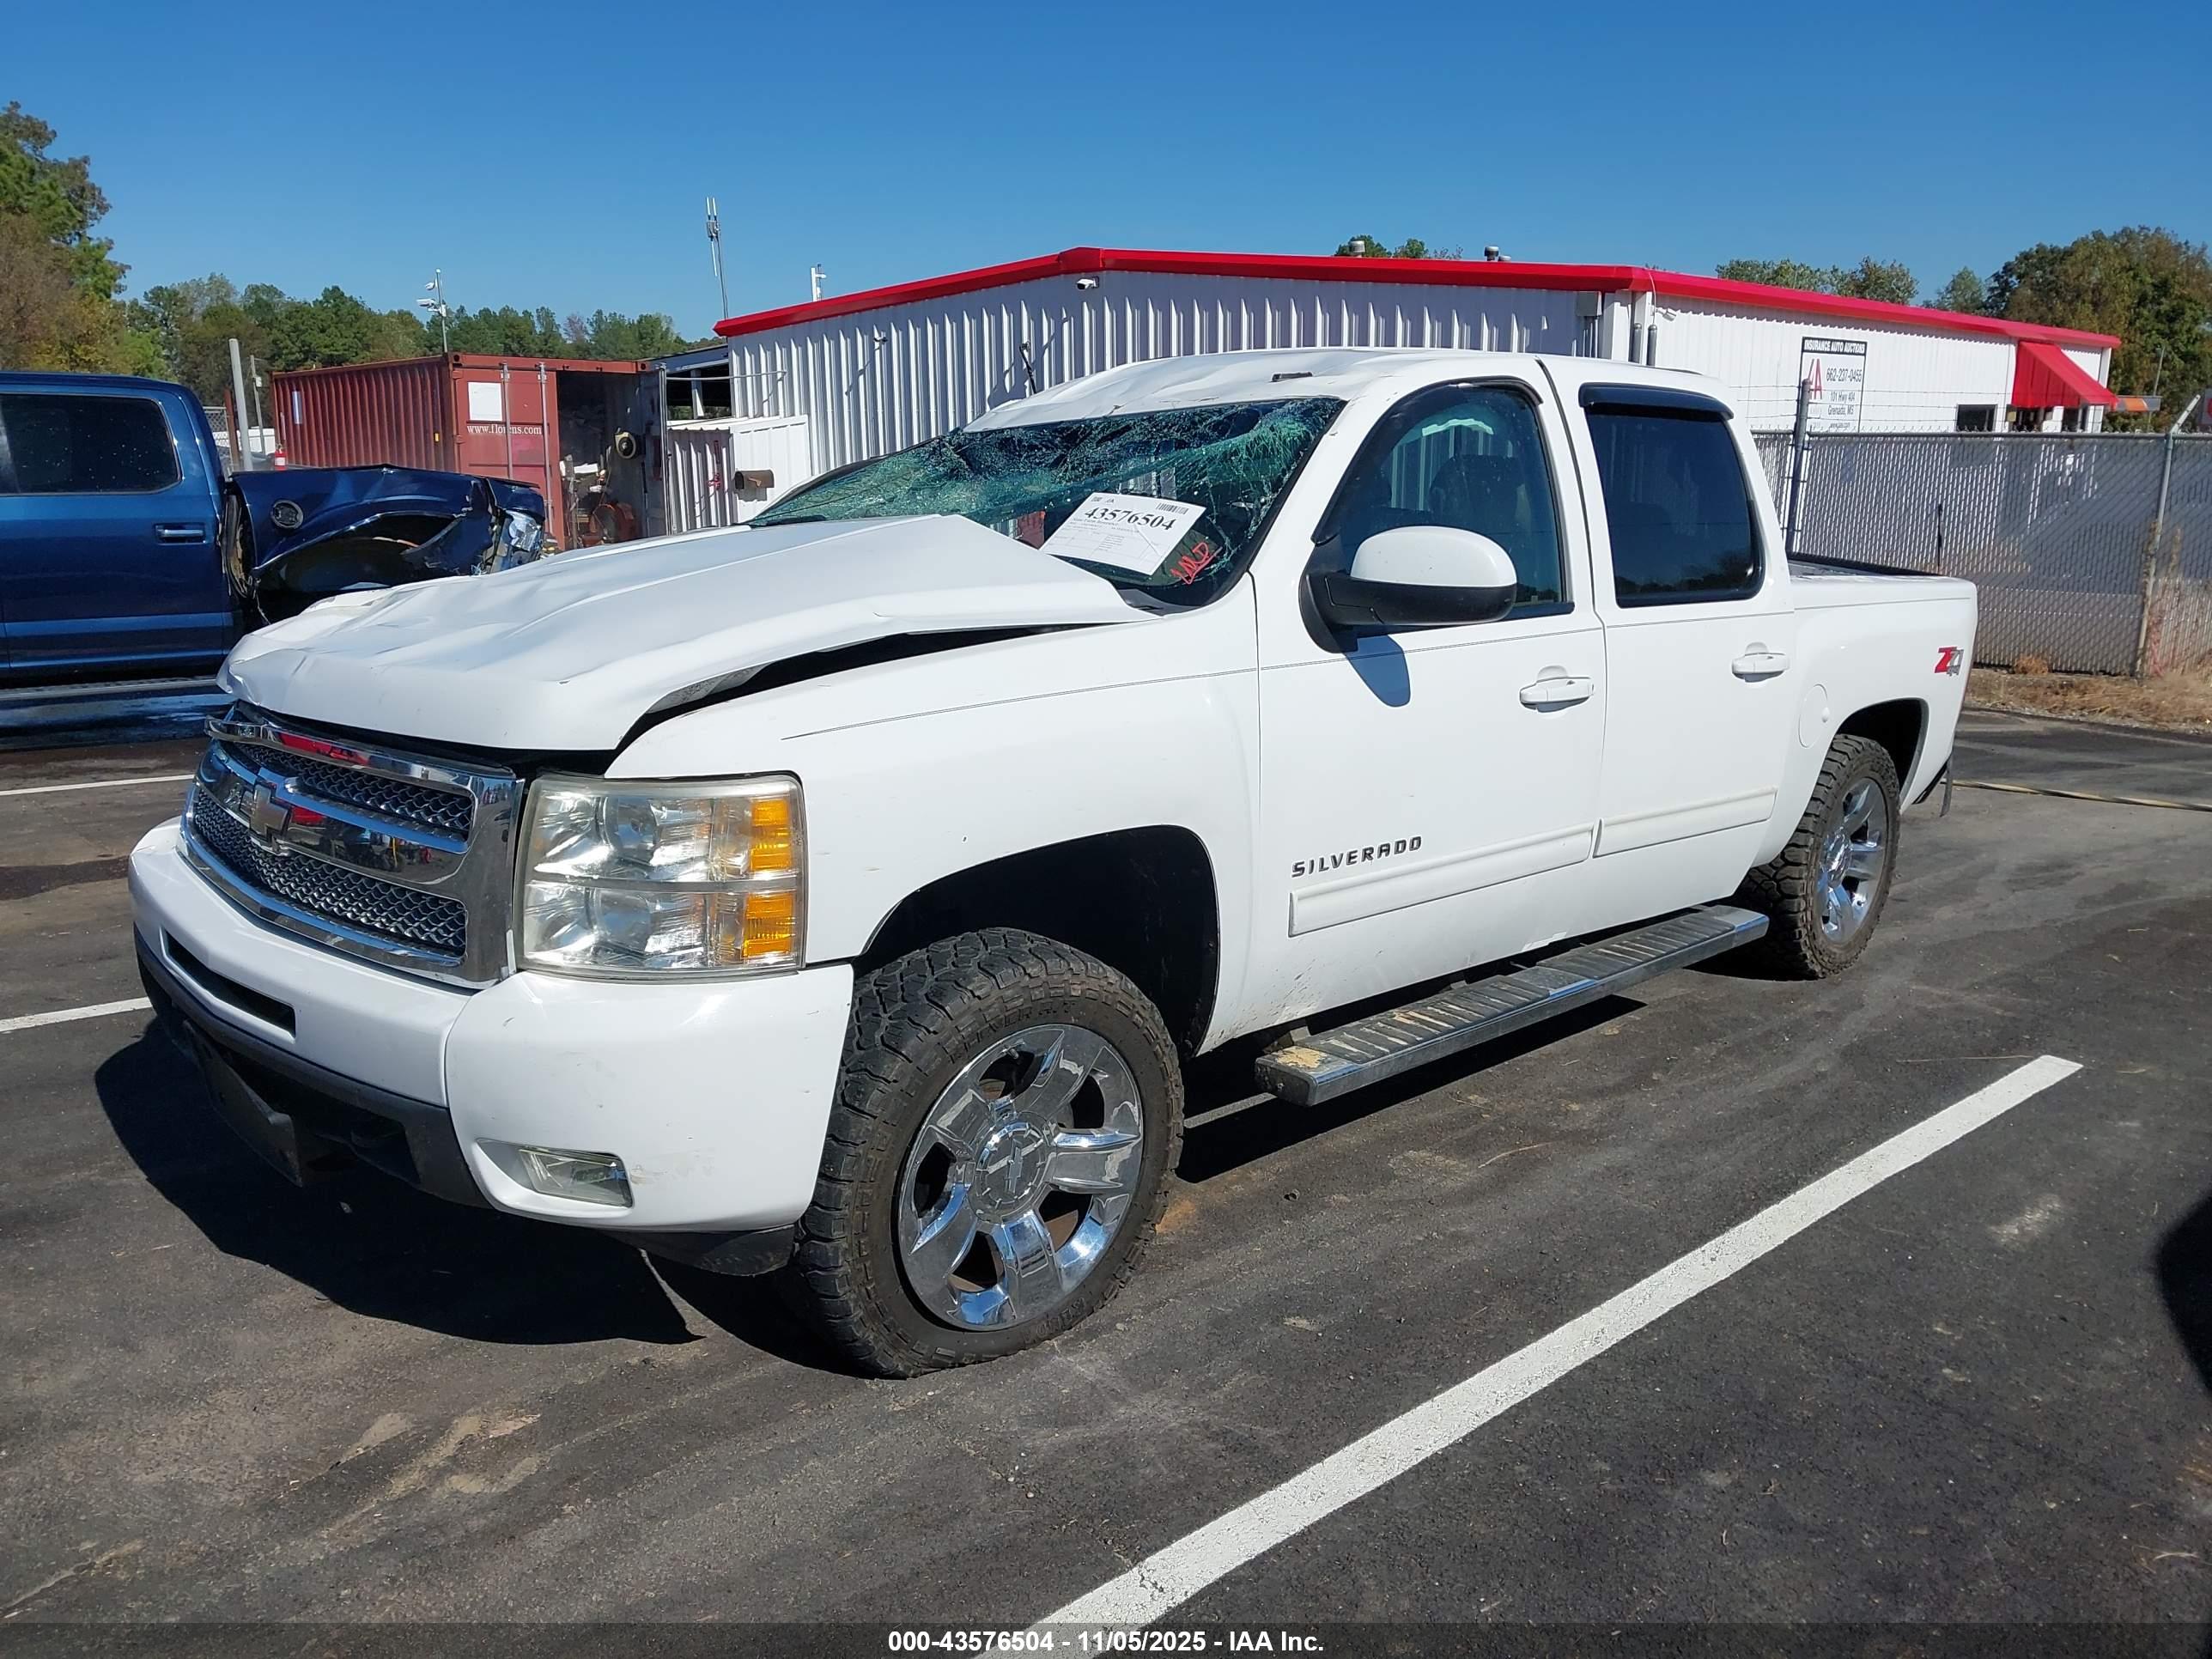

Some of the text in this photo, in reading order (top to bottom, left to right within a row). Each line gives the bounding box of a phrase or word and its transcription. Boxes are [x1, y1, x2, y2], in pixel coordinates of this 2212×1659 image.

[1804, 339, 1865, 353] INSURANCE AUTO AUCTIONS
[1085, 507, 1176, 531] 43576504
[1291, 836, 1422, 878] SILVERADO
